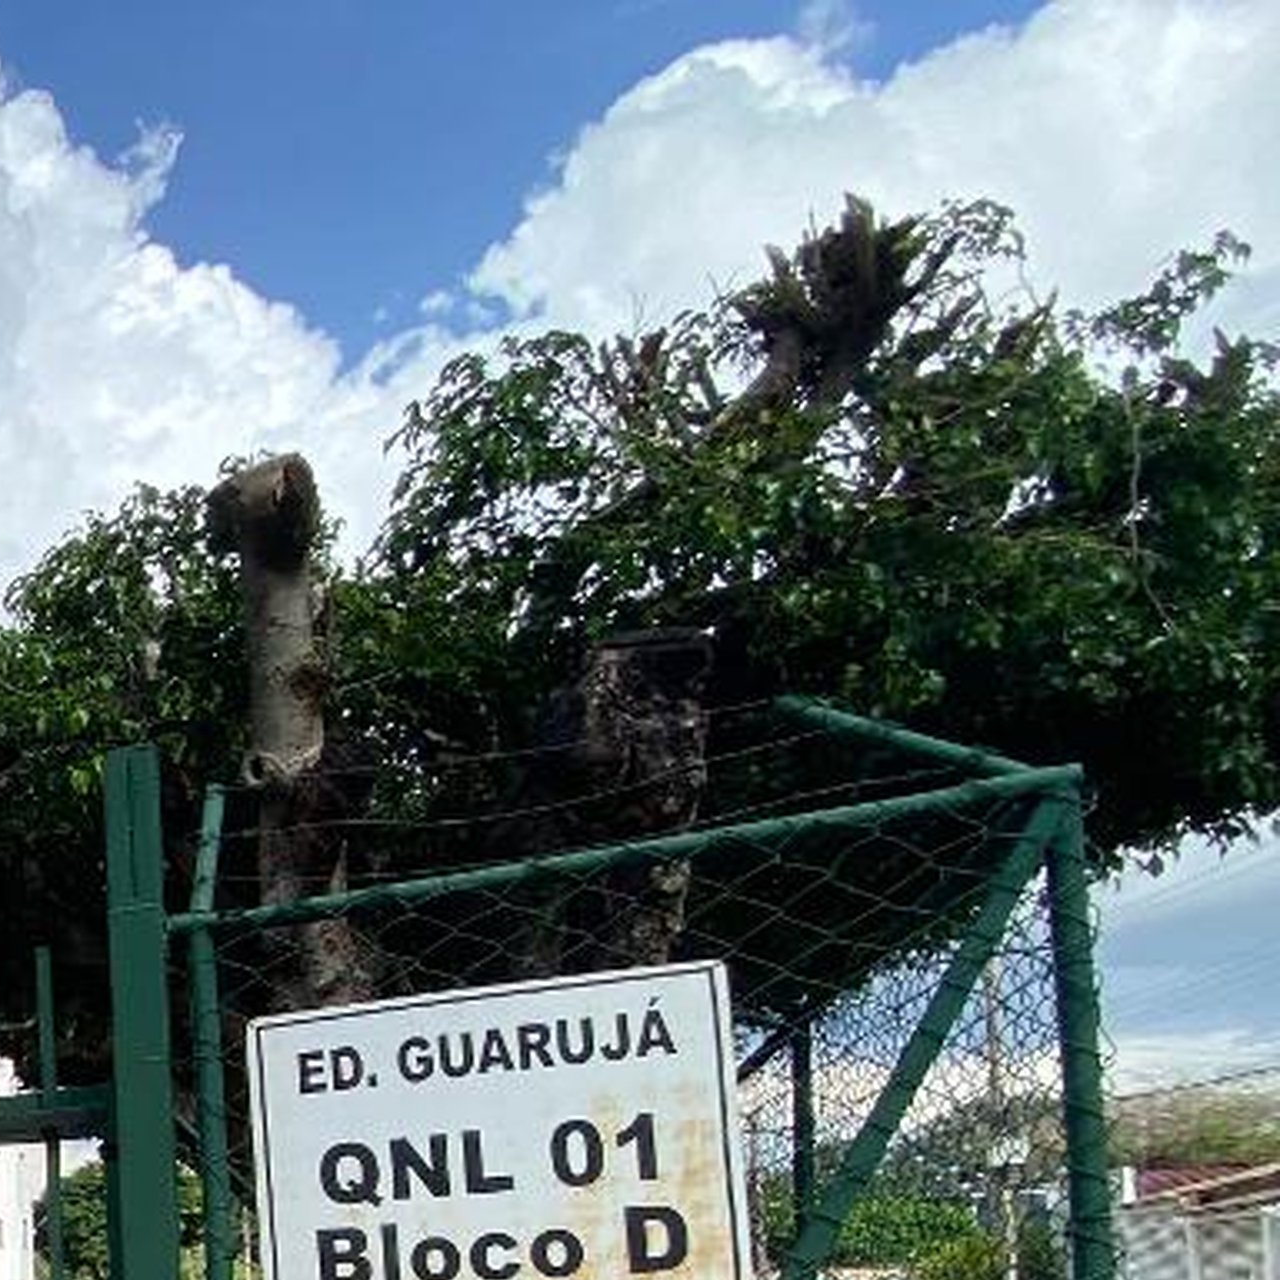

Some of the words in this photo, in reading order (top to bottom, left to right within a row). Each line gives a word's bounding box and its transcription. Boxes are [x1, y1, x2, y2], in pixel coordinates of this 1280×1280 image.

[297, 1046, 378, 1094] ED.
[397, 998, 678, 1083] GUARUJÁ
[319, 1130, 515, 1207] QNL
[550, 1113, 659, 1188] 01
[624, 1205, 689, 1274] D
